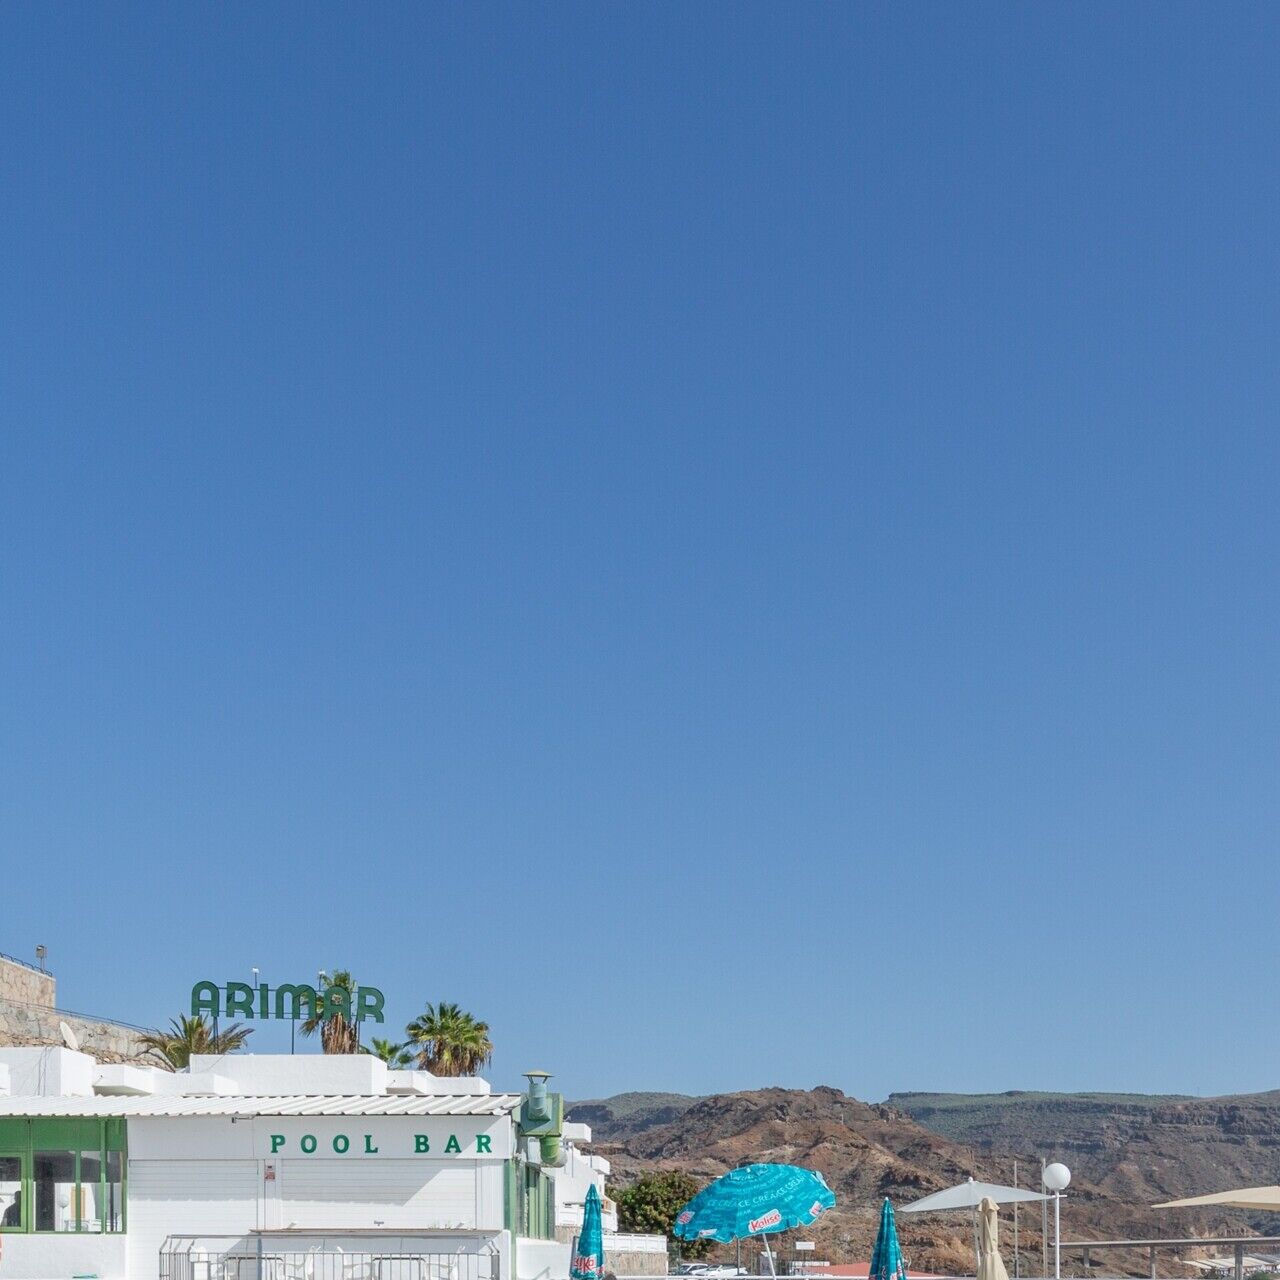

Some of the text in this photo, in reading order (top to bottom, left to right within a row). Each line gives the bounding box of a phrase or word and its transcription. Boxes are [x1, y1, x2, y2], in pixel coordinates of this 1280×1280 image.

[191, 981, 385, 1023] ARIMAR
[270, 1134, 492, 1154] POOL BAR
[751, 1213, 781, 1231] Kalise
